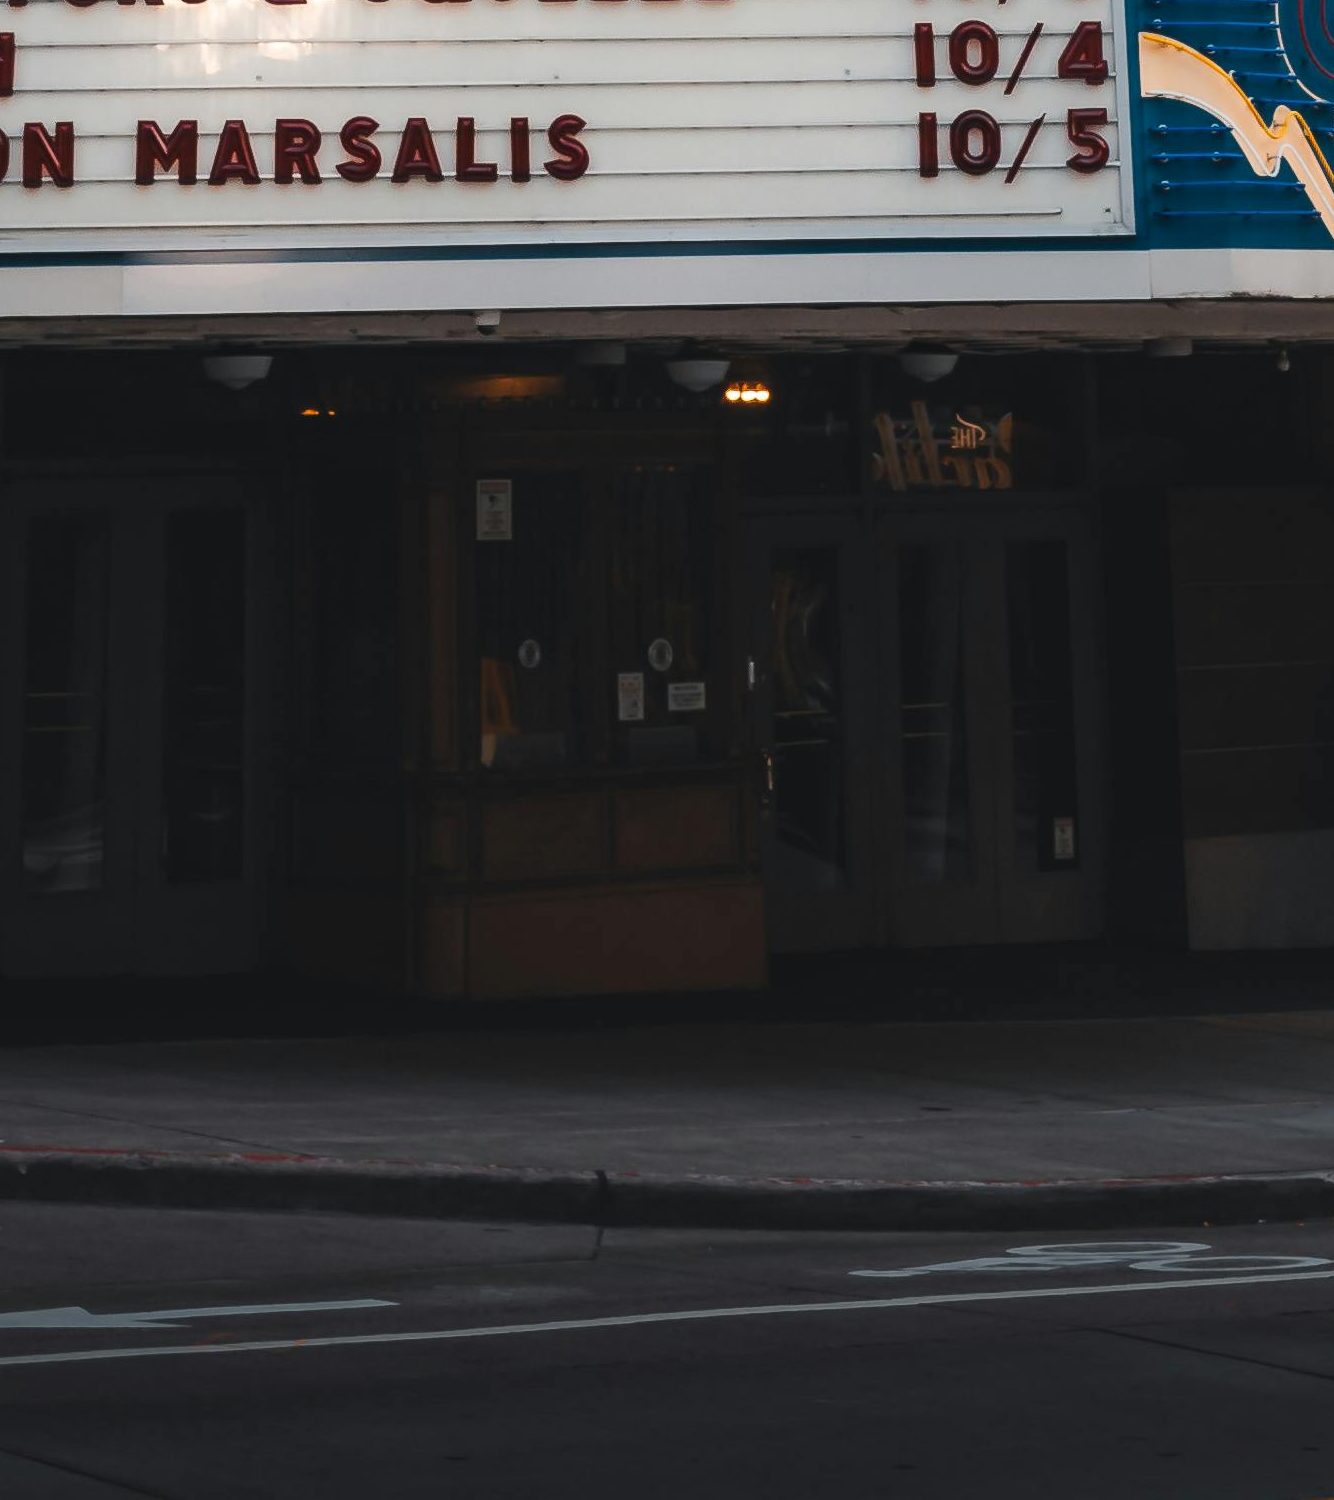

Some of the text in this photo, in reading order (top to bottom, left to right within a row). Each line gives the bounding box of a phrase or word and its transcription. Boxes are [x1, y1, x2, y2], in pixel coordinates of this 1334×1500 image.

[914, 20, 1111, 95] 10/4
[135, 114, 590, 188] MARSALIS
[918, 107, 1113, 182] 10/5
